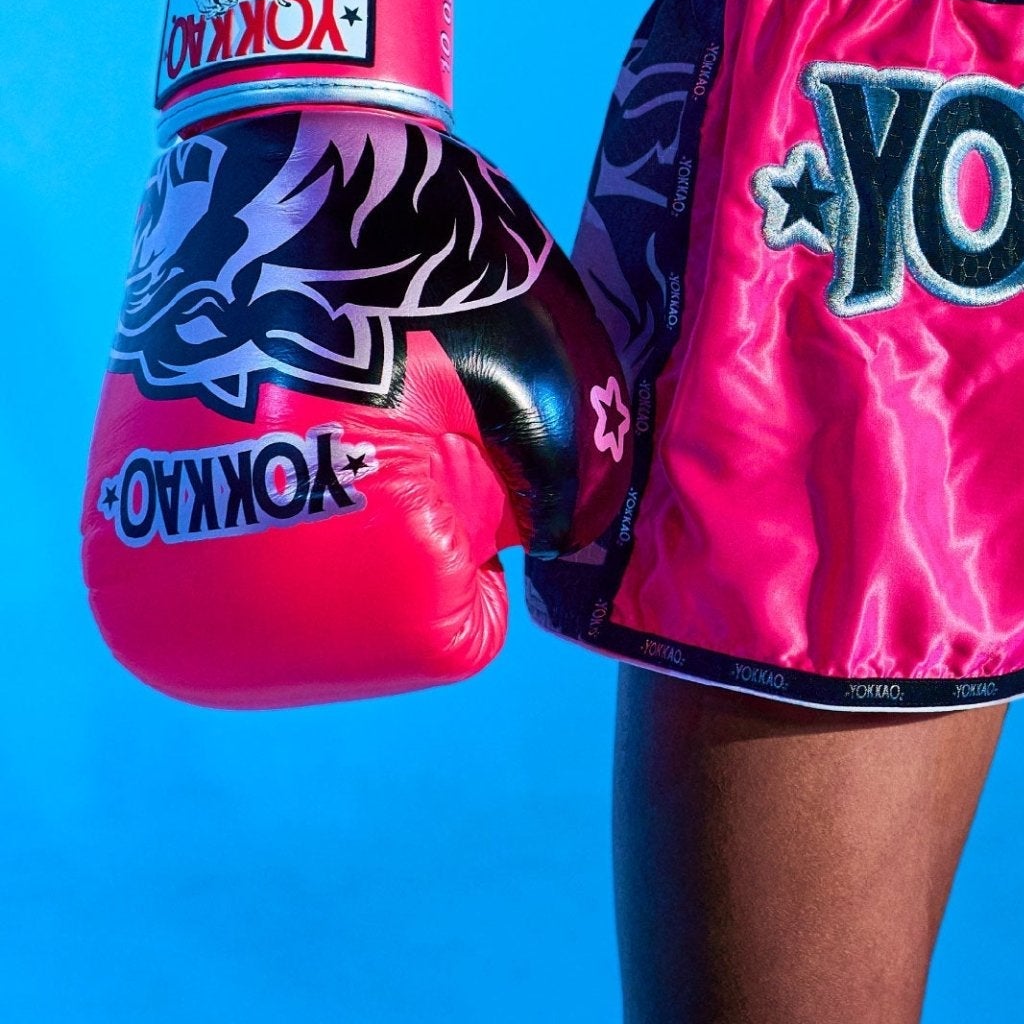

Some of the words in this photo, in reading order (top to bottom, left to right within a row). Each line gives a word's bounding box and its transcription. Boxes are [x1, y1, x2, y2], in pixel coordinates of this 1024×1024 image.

[693, 45, 720, 97] YOKKAO
[671, 159, 692, 213] YOKKAO
[667, 275, 681, 326] YOKKAO
[120, 432, 356, 538] YOKKAO
[619, 491, 638, 543] YOKKAO
[735, 663, 785, 689] YOKKAO
[850, 684, 901, 700] YOKKAO
